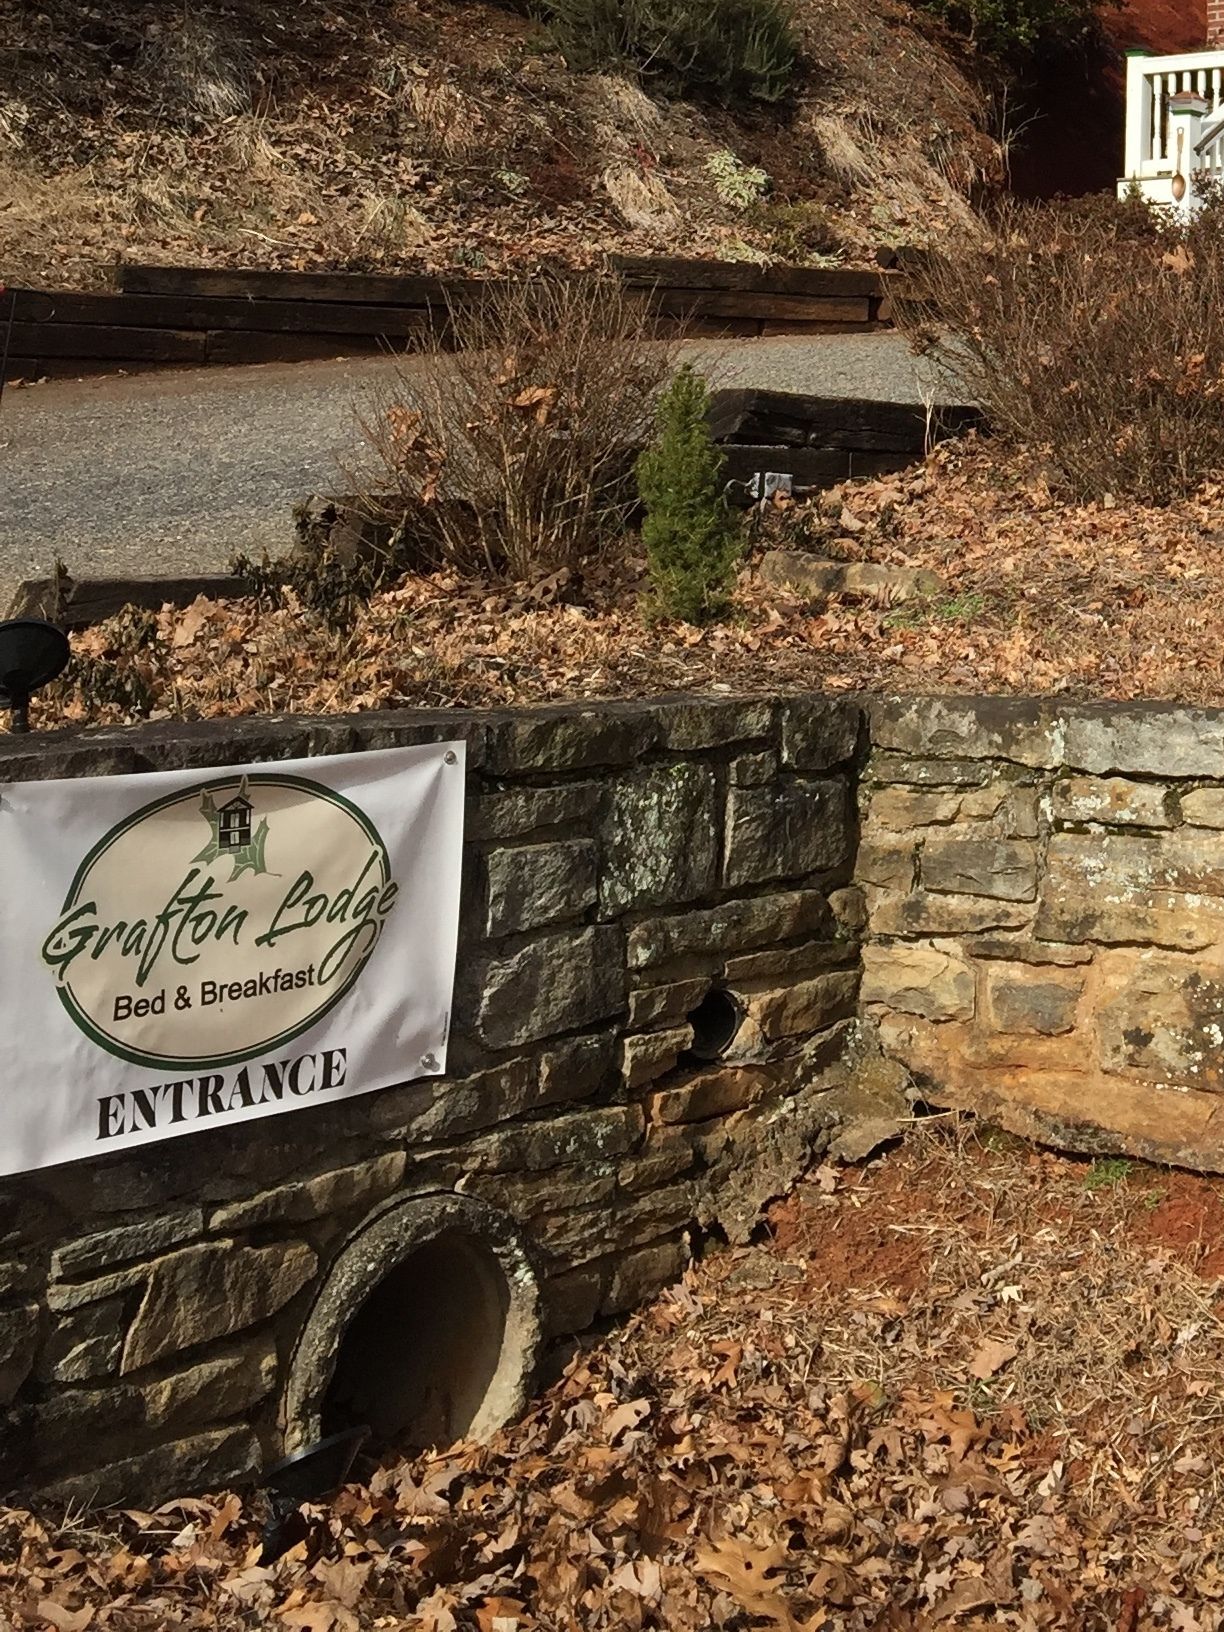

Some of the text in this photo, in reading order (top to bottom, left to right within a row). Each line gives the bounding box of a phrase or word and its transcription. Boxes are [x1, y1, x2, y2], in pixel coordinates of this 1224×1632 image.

[42, 850, 398, 987] Grafton Lodge
[113, 964, 315, 1022] Bed & Breakfast
[96, 1047, 348, 1141] ENTRANCE
